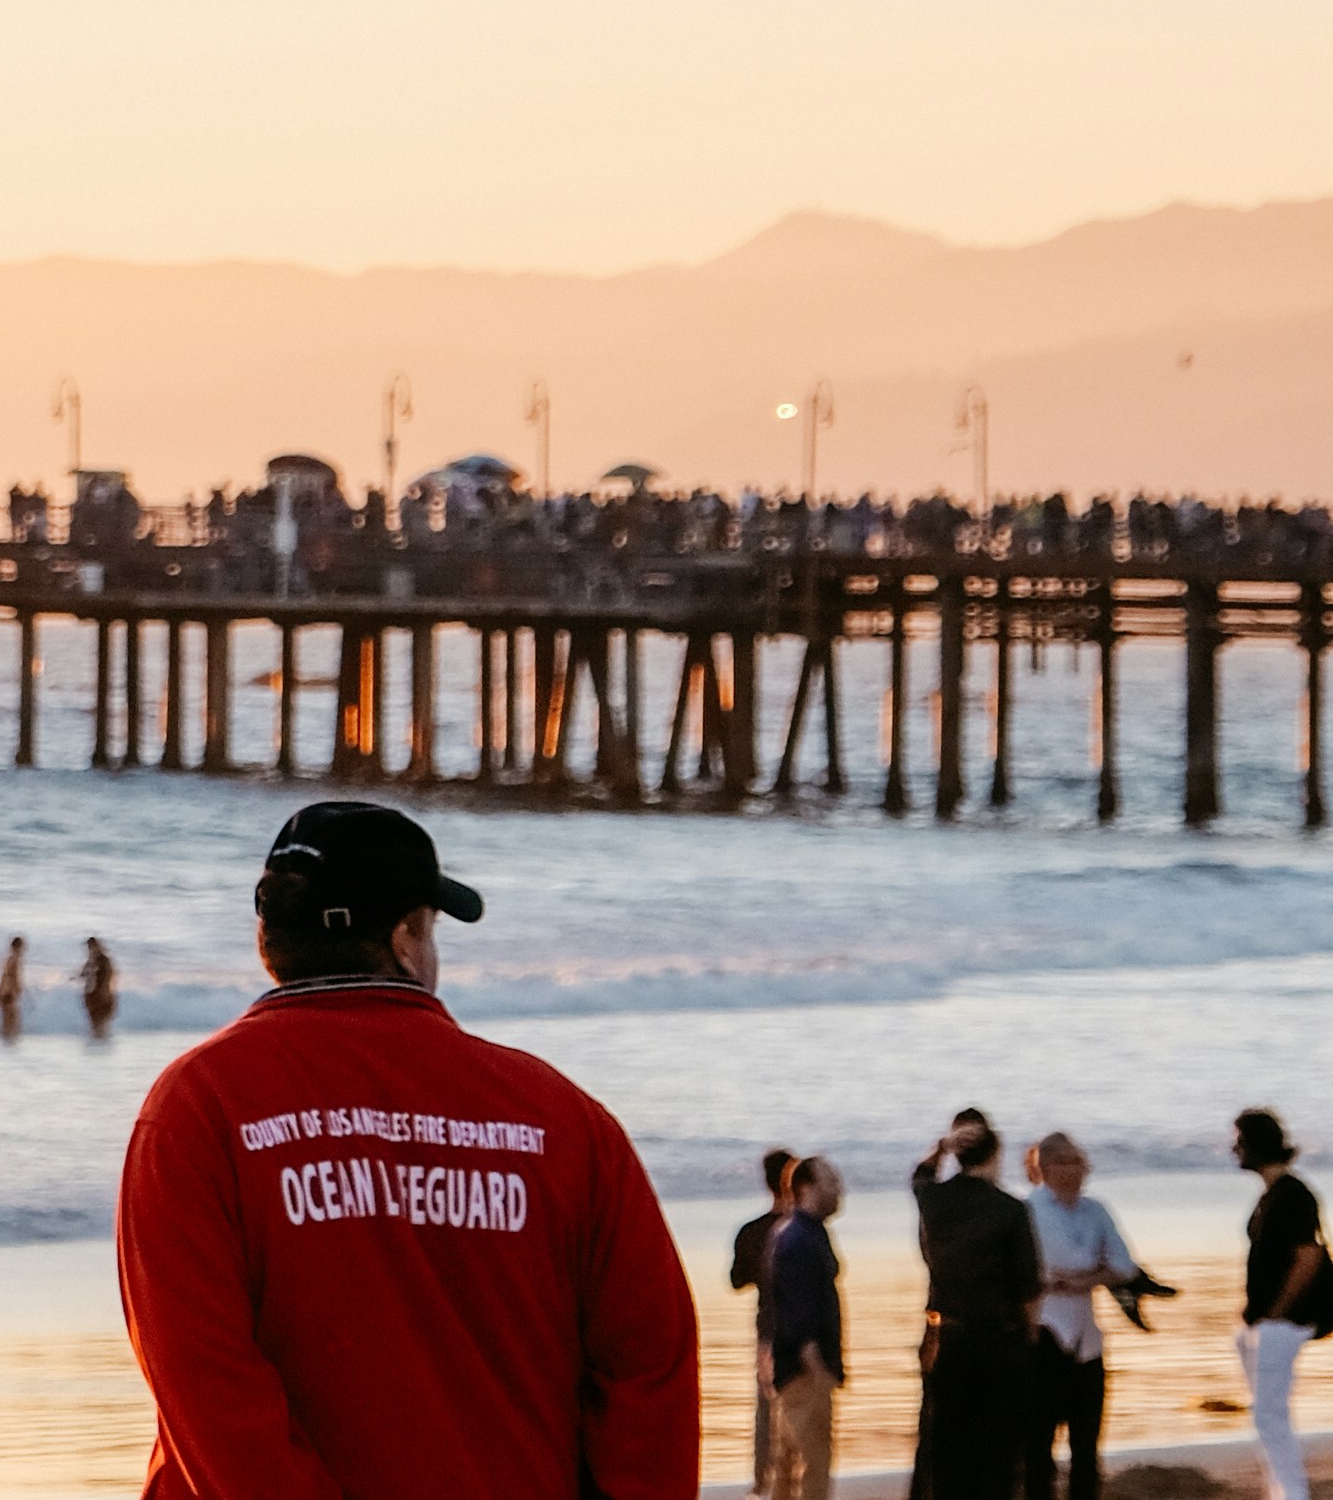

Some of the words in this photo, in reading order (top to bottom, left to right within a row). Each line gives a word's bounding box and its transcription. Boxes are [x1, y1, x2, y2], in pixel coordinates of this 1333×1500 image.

[241, 1114, 301, 1151] COUNTY
[300, 1109, 323, 1138] OF
[413, 1114, 447, 1145] FIRE
[449, 1119, 545, 1155] DEPARTMENT
[282, 1158, 376, 1225] OCEAN
[376, 1159, 527, 1232] LFEGUARD
